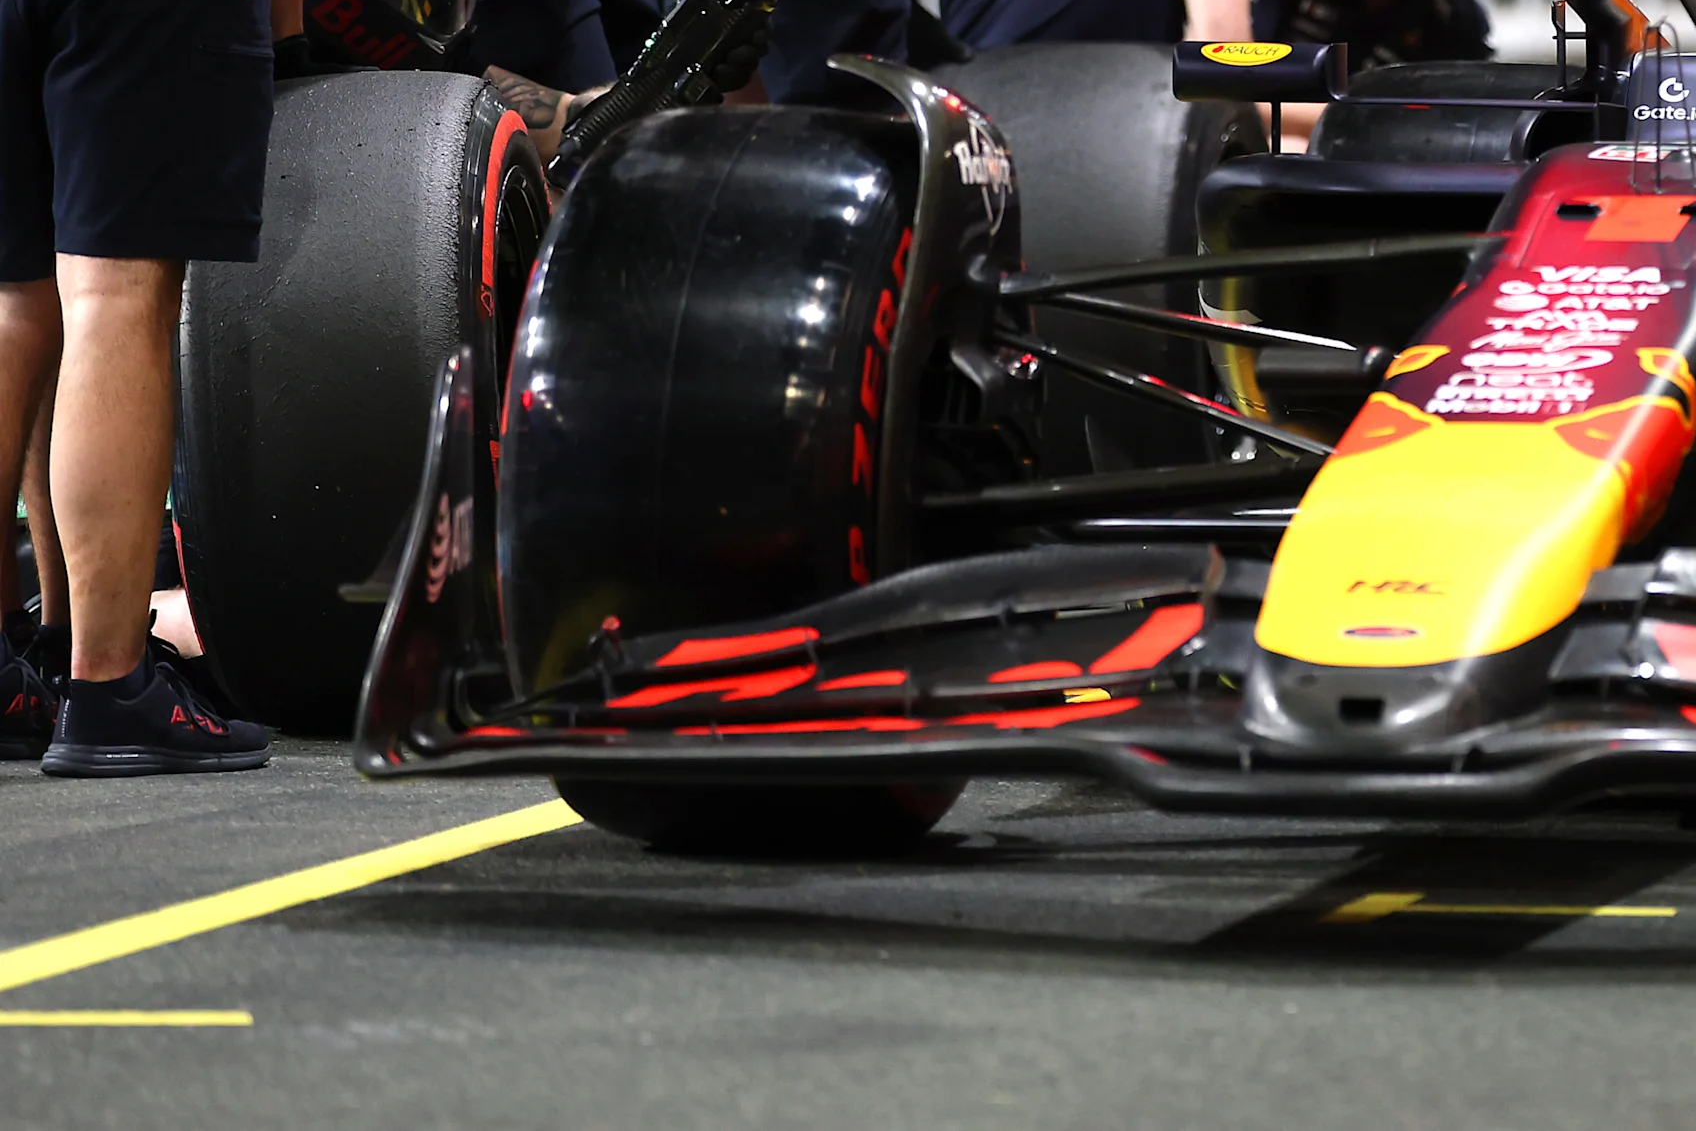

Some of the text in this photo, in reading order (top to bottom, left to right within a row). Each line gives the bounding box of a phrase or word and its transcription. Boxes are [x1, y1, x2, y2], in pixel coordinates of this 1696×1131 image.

[1223, 45, 1280, 56] RAUCH
[1533, 266, 1661, 283] VISA
[1554, 297, 1659, 311] AT&T
